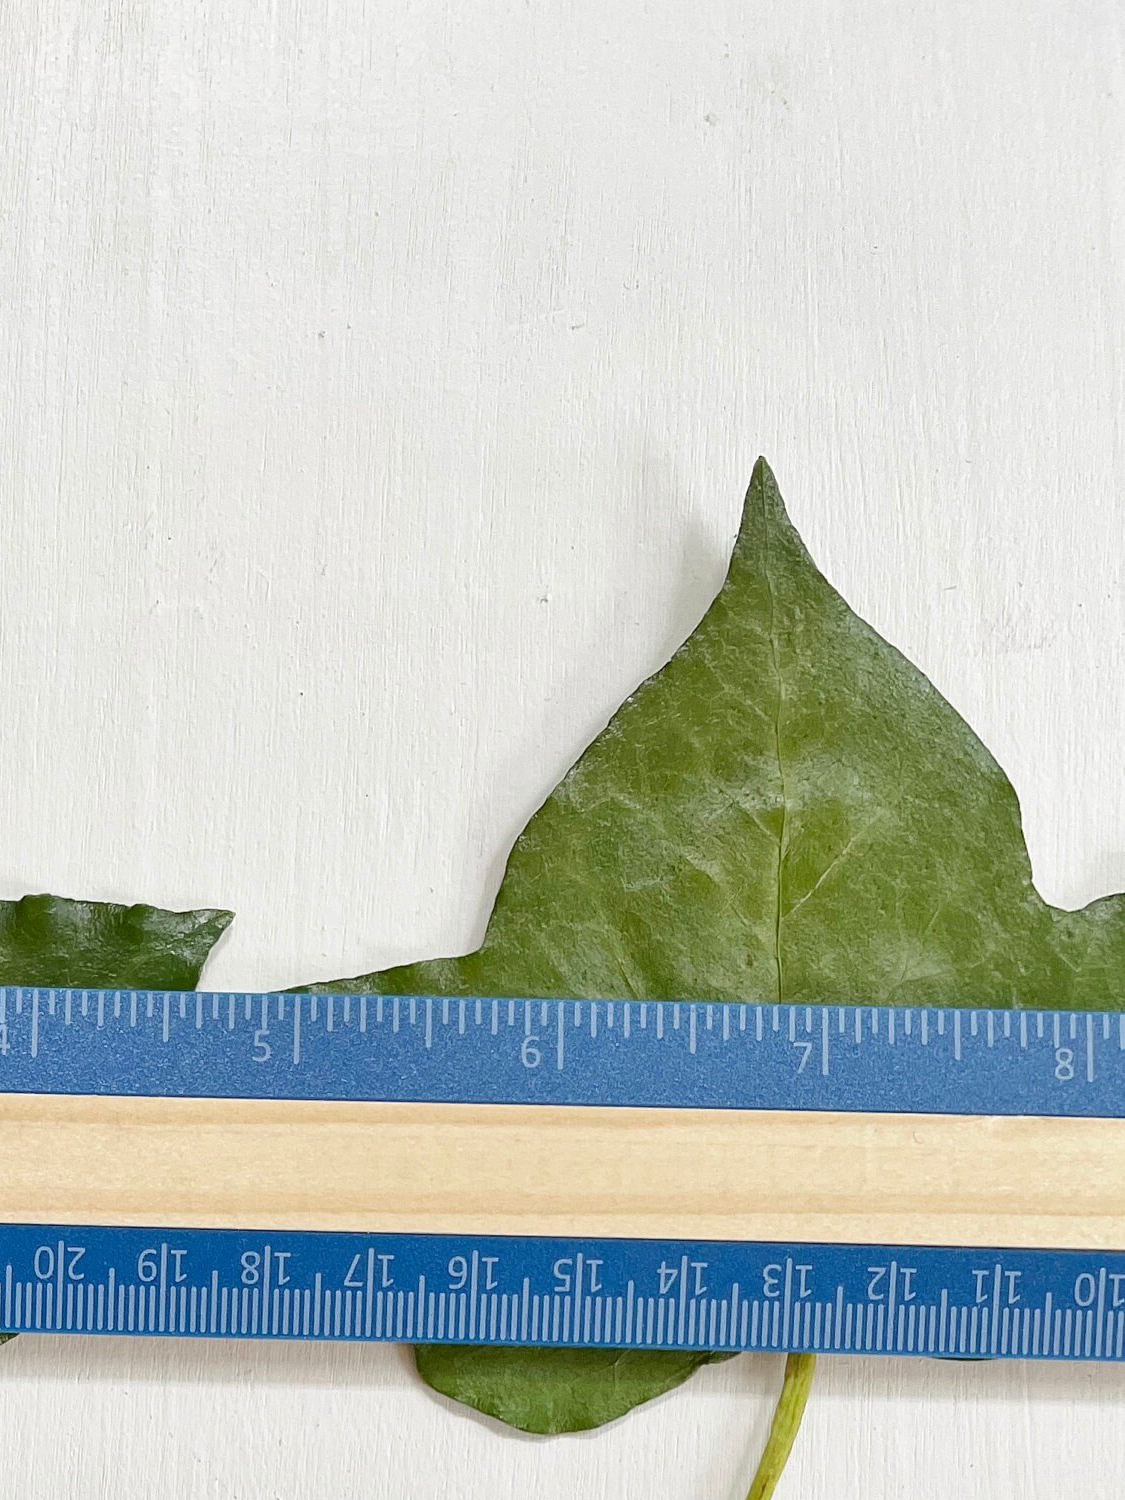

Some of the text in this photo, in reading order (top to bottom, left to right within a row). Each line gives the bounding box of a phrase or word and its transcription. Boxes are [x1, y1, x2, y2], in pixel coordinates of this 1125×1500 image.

[252, 1029, 272, 1063] 5
[521, 1036, 541, 1069] 6
[793, 1042, 813, 1074] 7
[1054, 1048, 1075, 1080] 8
[34, 1245, 86, 1281] 20
[138, 1248, 188, 1284] 19
[240, 1250, 291, 1286] 18
[344, 1253, 395, 1289] 17
[448, 1255, 499, 1291] 16
[553, 1258, 604, 1294] 15
[657, 1261, 708, 1296] 14
[762, 1264, 813, 1299] 13
[867, 1267, 918, 1301] 12
[972, 1270, 1022, 1304] 11
